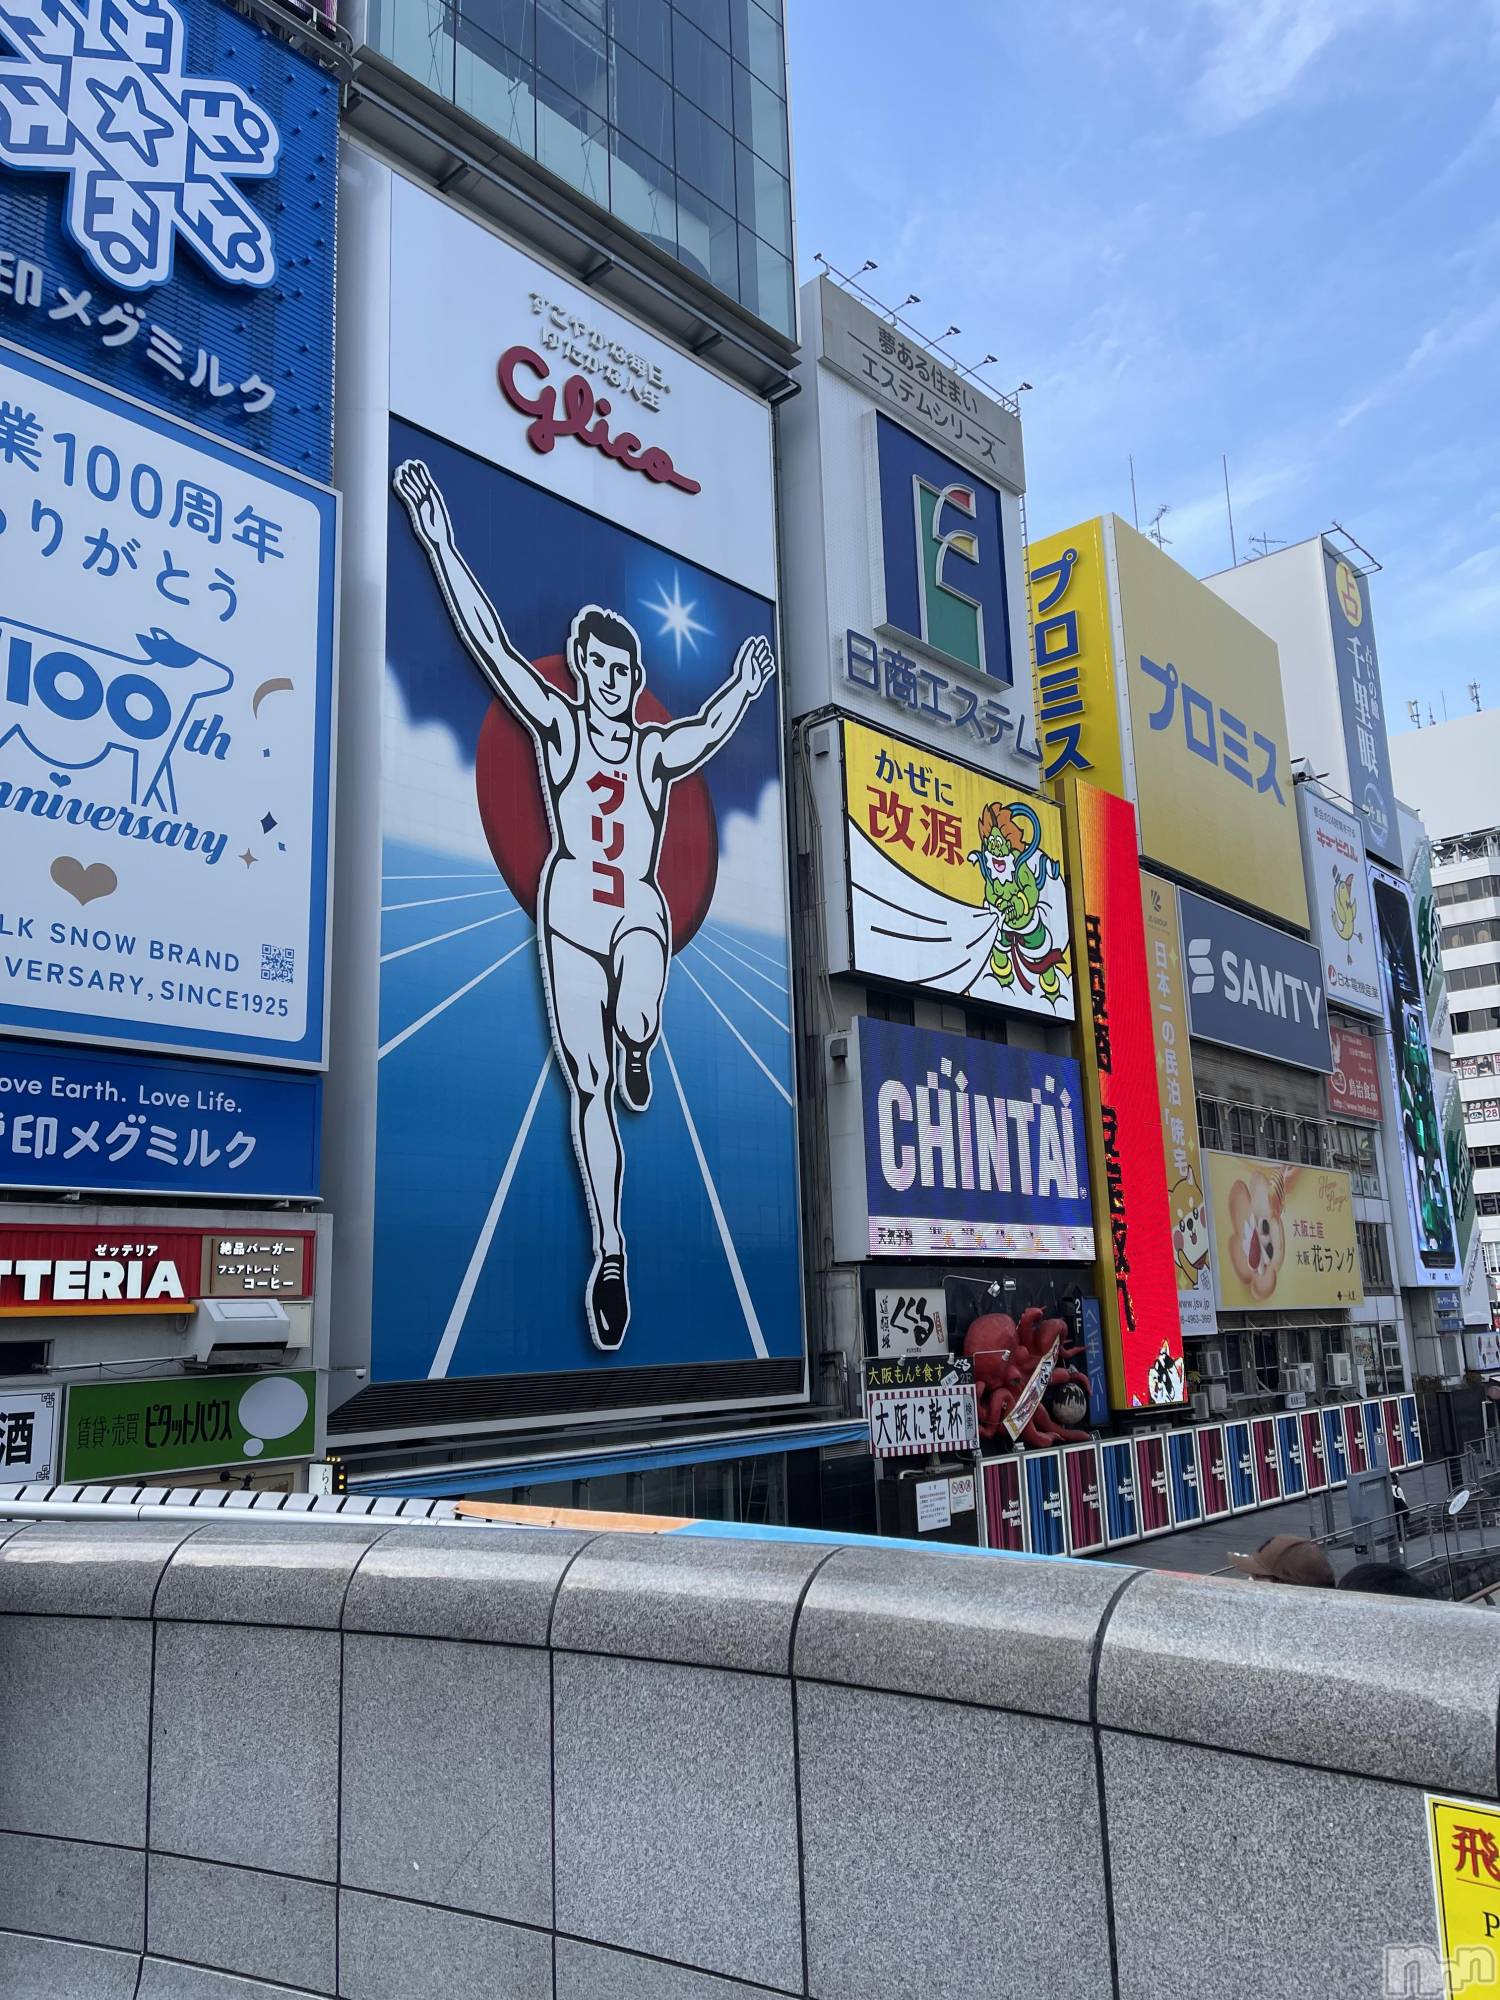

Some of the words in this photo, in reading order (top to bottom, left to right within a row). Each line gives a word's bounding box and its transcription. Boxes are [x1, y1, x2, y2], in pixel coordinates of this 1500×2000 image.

[878, 326, 978, 413] 夢ある住まい
[497, 346, 701, 495] Glico
[862, 354, 996, 464] エステムシリーズ
[0, 499, 237, 622] りがとう
[847, 629, 1043, 762] 日商エステム
[1030, 548, 1094, 782] プロミス
[1140, 655, 1286, 807] プロミス
[1347, 636, 1379, 778] 千里眼
[874, 749, 954, 806] かぜに
[586, 770, 628, 908] グリコ
[867, 785, 965, 866] 改源
[50, 923, 136, 955] SNOW
[150, 939, 240, 973] BRAND
[1222, 950, 1321, 1030] SAMTY
[52, 1076, 126, 1102] Earth.
[139, 1085, 189, 1108] Love
[197, 1090, 242, 1113] Life.
[0, 1112, 256, 1168] 印メグミルク
[94, 1244, 158, 1257] ゼッテリア
[218, 1264, 280, 1275] フェアトレード
[219, 1242, 295, 1256] 絶品バーガー
[243, 1277, 295, 1290] コーヒー
[868, 1363, 945, 1386] 大阪もんを食す
[145, 1399, 233, 1449] ピタットハウス
[875, 1397, 962, 1446] 大阪に乾杯
